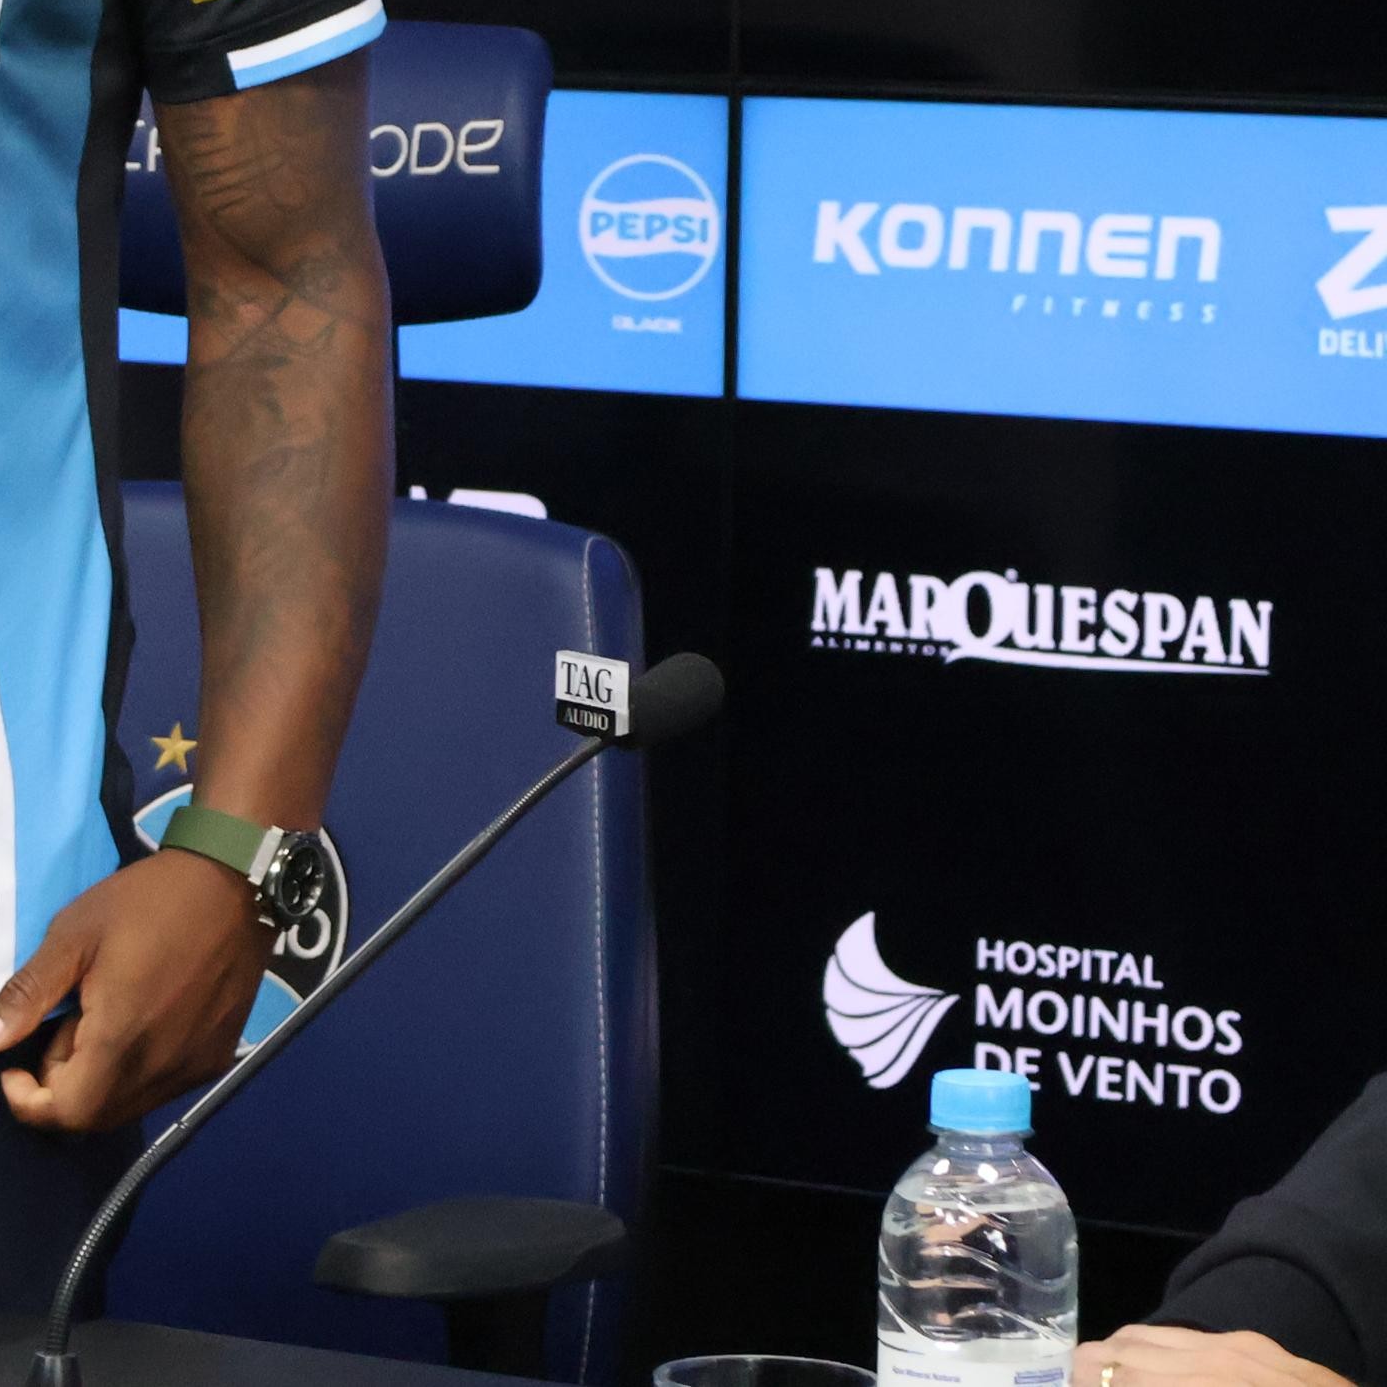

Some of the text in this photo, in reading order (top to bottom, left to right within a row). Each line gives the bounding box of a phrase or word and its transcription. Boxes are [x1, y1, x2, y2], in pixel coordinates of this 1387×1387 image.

[590, 211, 709, 244] PEPSI
[814, 201, 1221, 282] KONNEN
[1012, 294, 1217, 324] FITNESS
[1318, 328, 1387, 358] DELI
[811, 567, 1274, 675] MARQUESPAN
[810, 636, 952, 658] ALIMENTOS
[560, 660, 613, 703] TAG
[564, 707, 609, 731] AUDIO
[976, 937, 1164, 990] HOSPITAL
[974, 984, 1243, 1056] MOINHOS
[1057, 1051, 1242, 1114] VENTO
